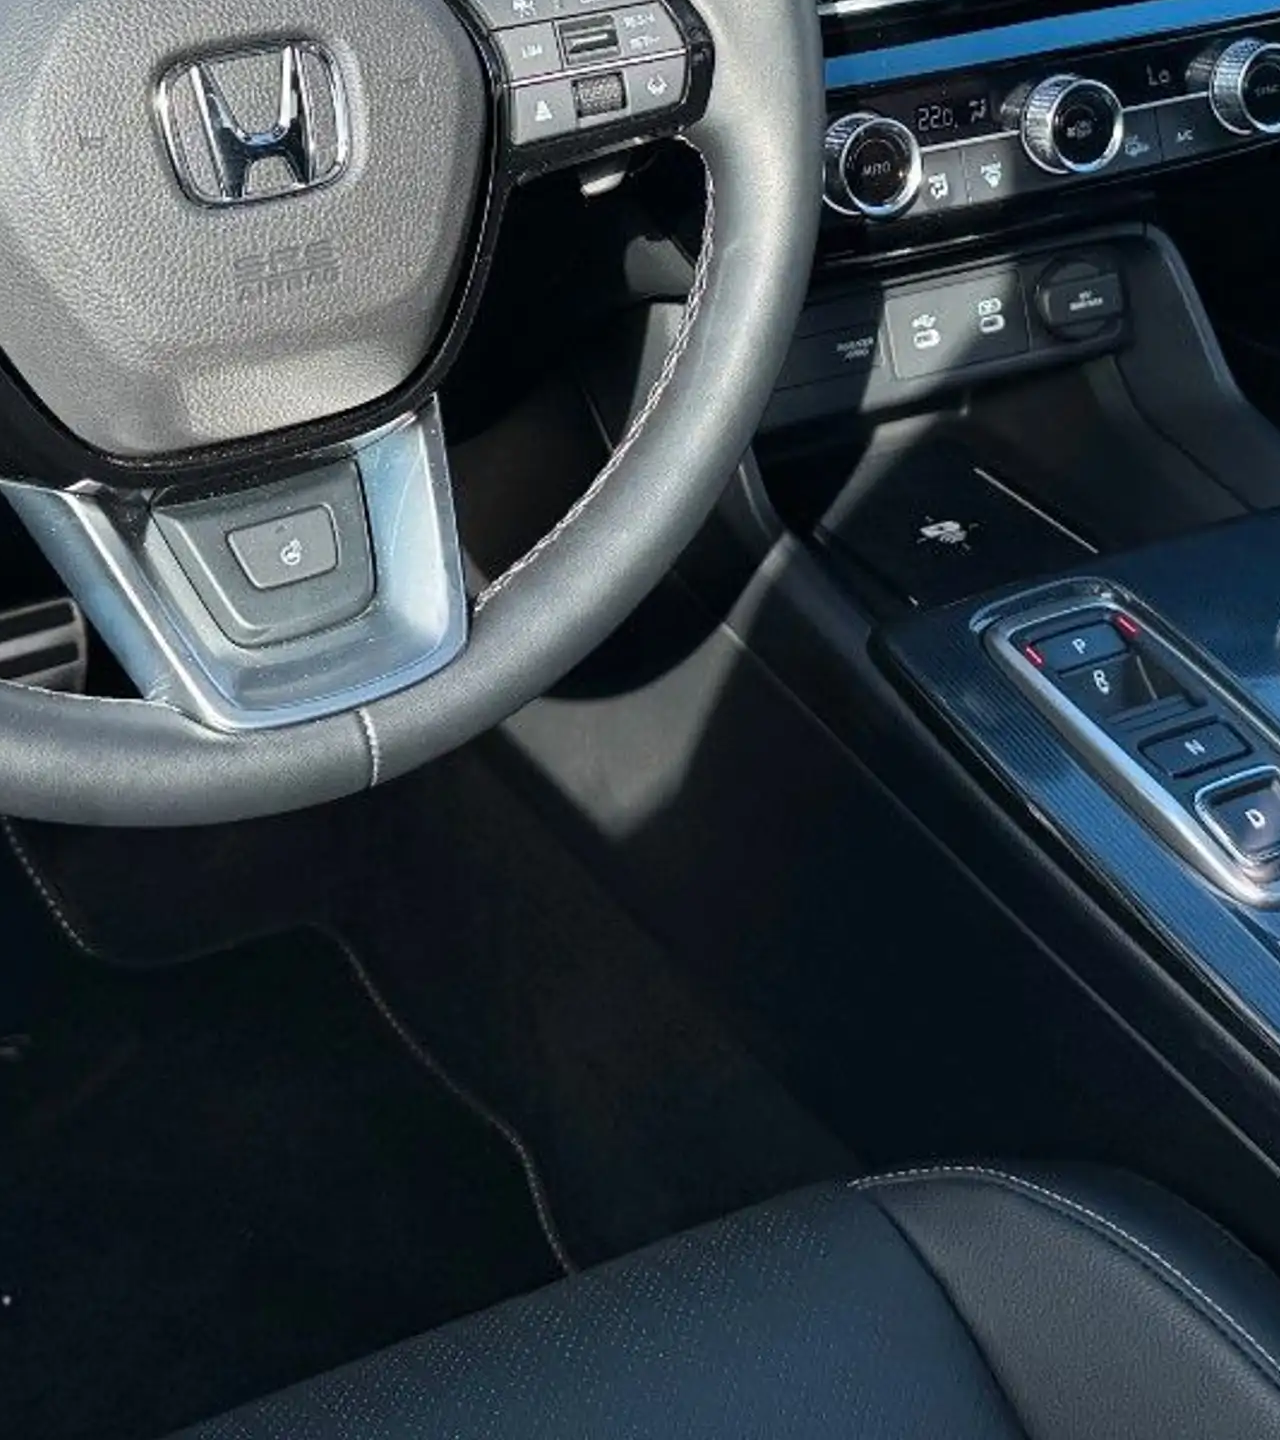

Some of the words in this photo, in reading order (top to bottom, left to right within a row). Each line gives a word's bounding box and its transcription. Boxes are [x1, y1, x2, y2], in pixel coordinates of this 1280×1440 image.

[1072, 637, 1087, 655] P
[1184, 738, 1206, 756] N
[1244, 807, 1267, 830] D
